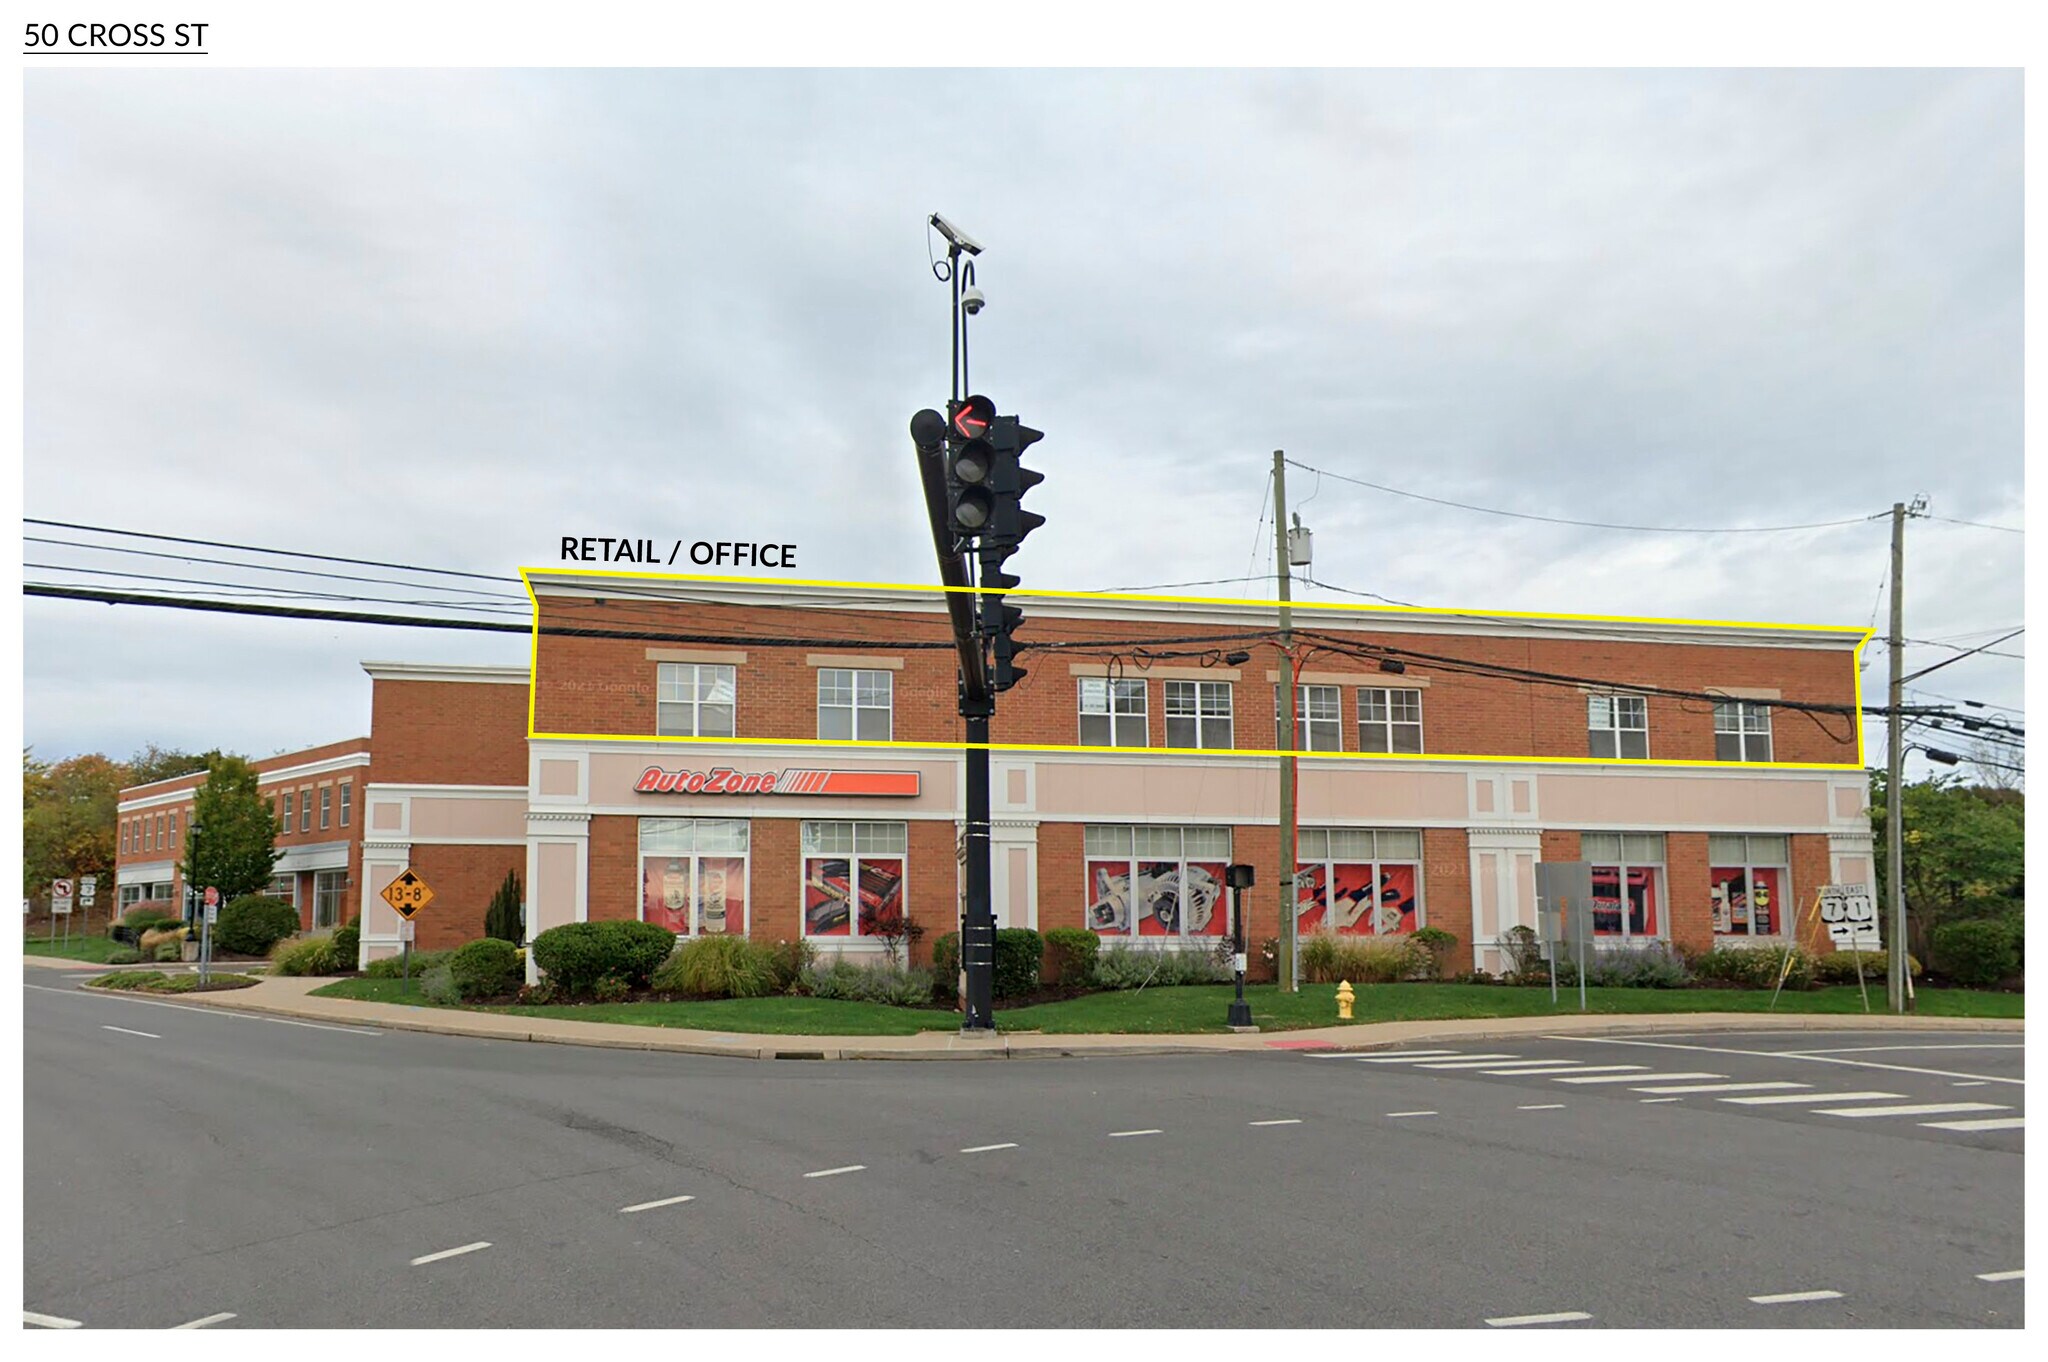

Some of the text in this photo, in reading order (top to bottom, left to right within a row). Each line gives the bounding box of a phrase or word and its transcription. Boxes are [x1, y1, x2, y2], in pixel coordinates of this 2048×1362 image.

[635, 767, 778, 793] AutoZone
[1845, 886, 1864, 895] EAST
[1826, 902, 1836, 917] 7
[1855, 901, 1862, 917] 1
